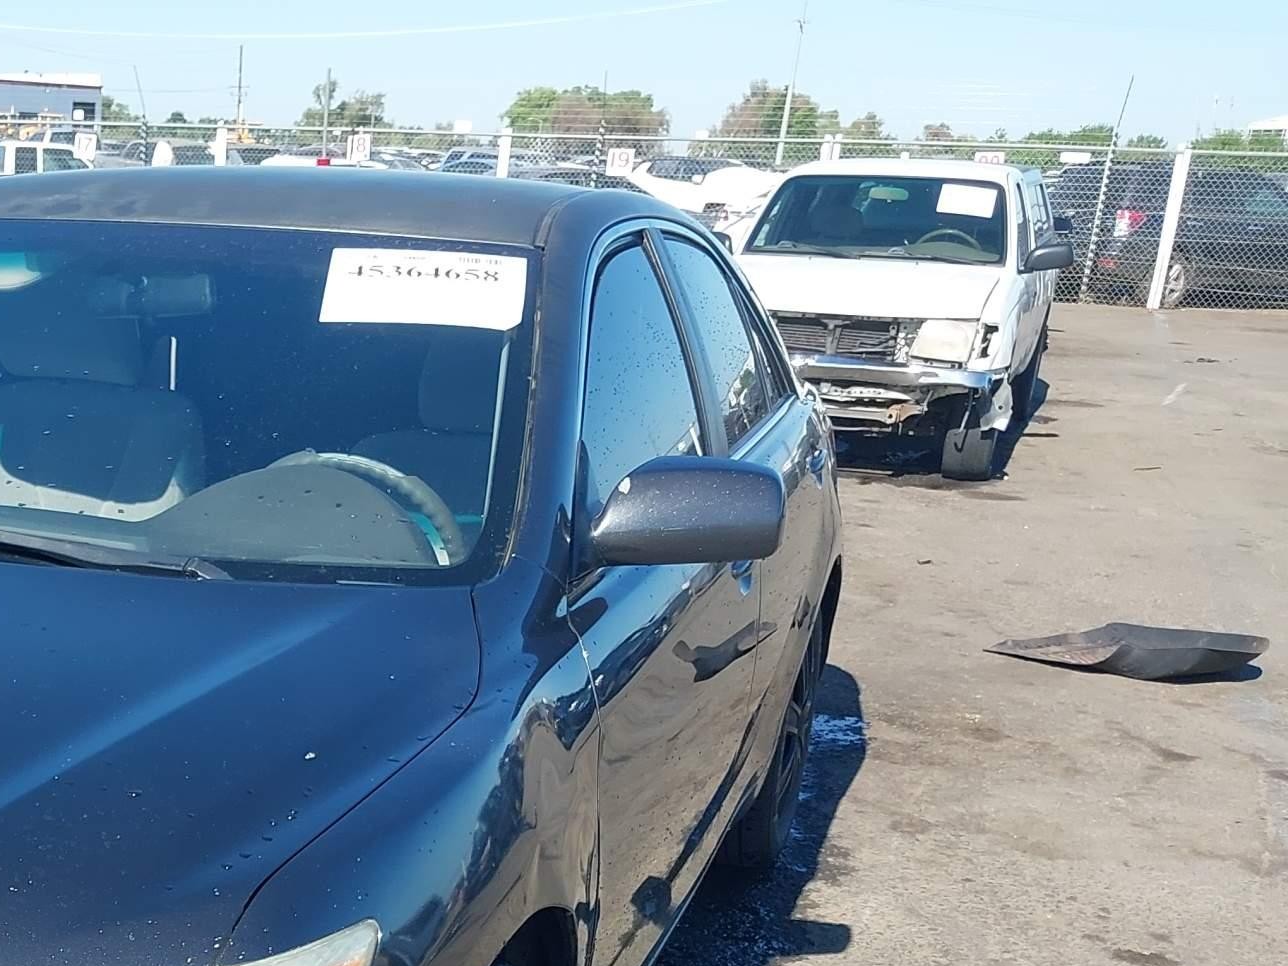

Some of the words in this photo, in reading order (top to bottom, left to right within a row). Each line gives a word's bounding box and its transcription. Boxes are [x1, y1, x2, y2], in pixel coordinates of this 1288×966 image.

[78, 137, 93, 152] 17
[611, 151, 630, 168] 19
[348, 264, 499, 282] 45364658
